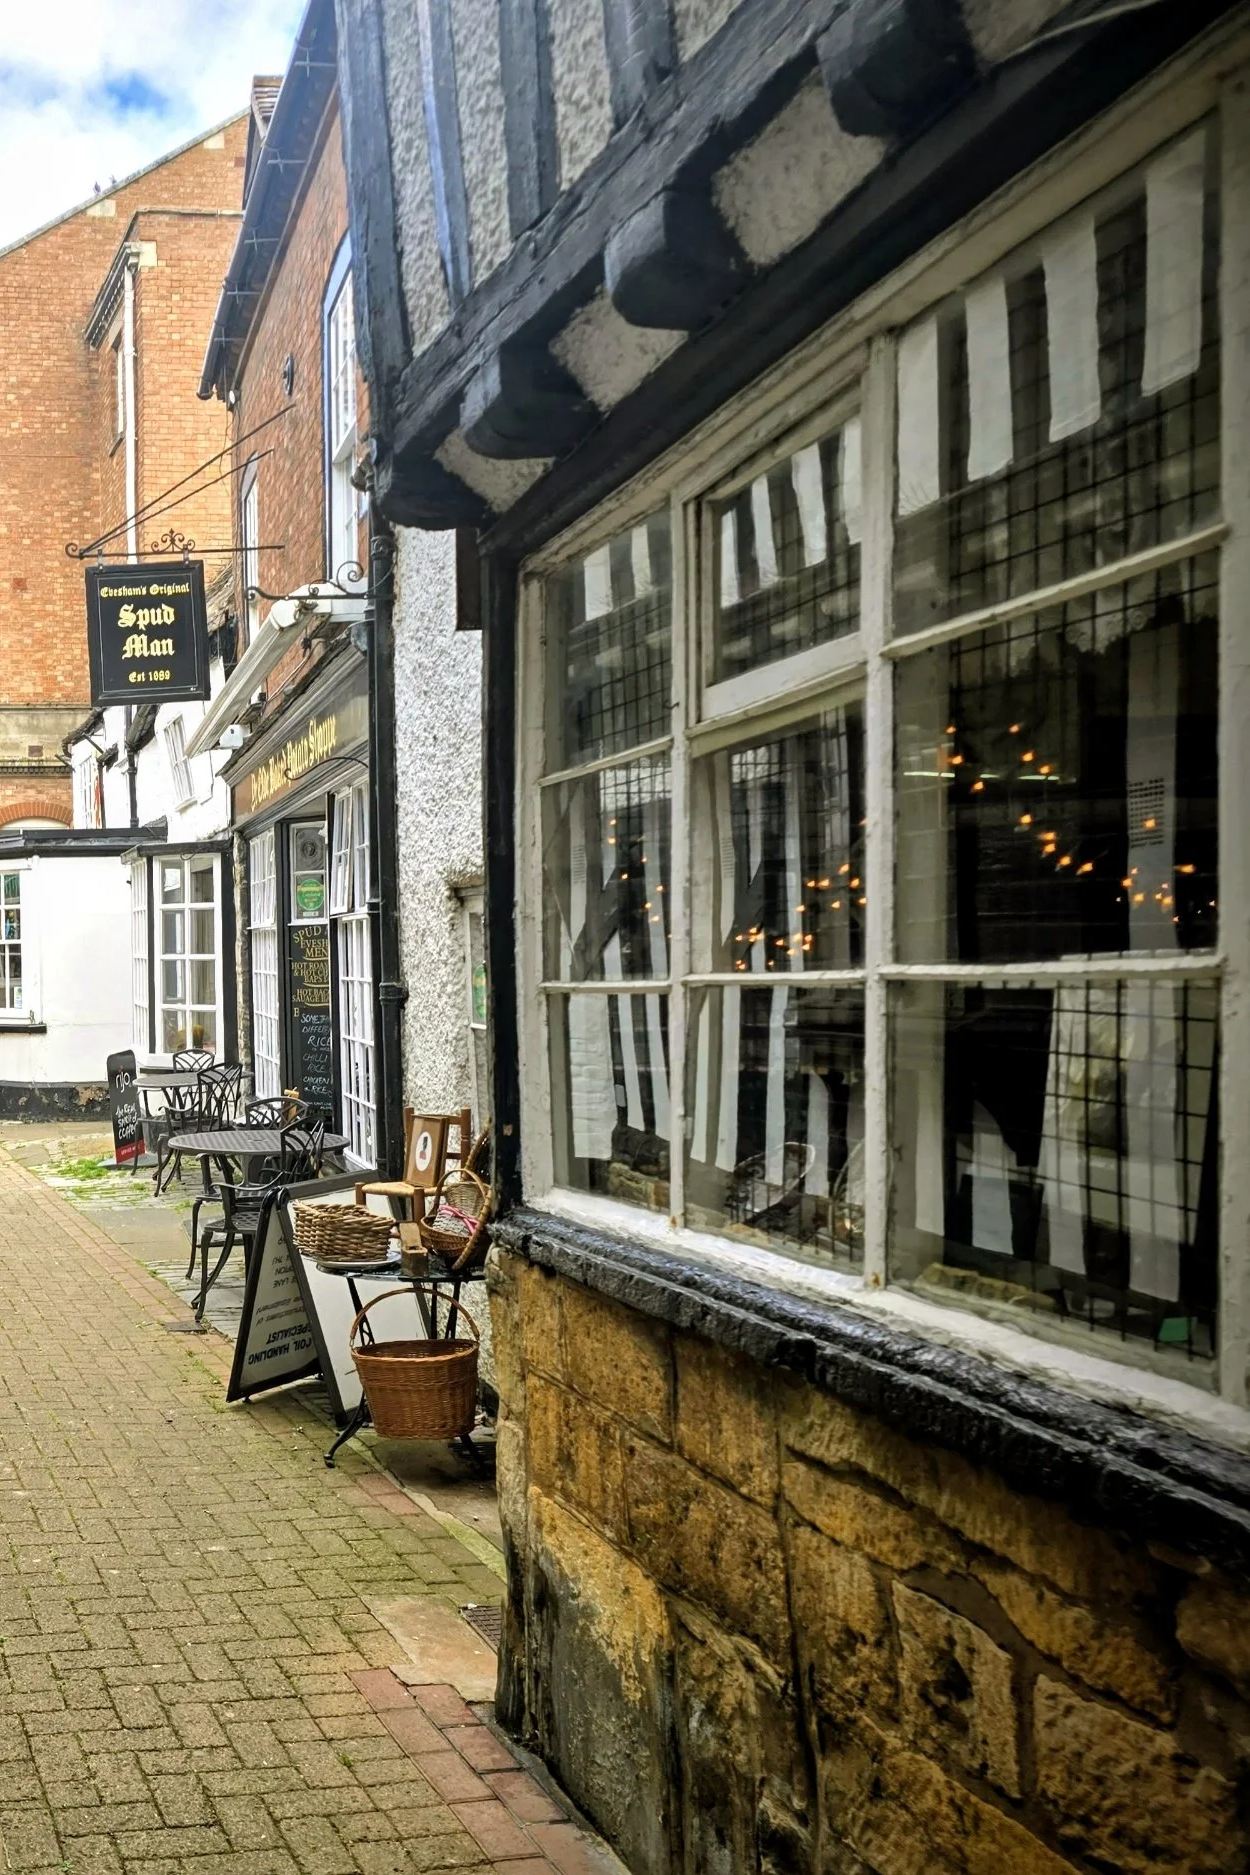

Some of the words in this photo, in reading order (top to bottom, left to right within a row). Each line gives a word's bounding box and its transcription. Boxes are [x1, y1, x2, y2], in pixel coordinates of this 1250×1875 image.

[100, 586, 147, 598] Evesham's
[150, 582, 190, 596] Original
[118, 603, 175, 630] Spud
[122, 634, 175, 660] Man
[128, 671, 145, 683] Est
[293, 926, 322, 943] SPUD
[300, 939, 328, 948] EVESH
[306, 948, 328, 957] MEN
[301, 1013, 329, 1024] SOMETH
[266, 1322, 312, 1344] SPECIALIST
[248, 1344, 290, 1365] HANDLING
